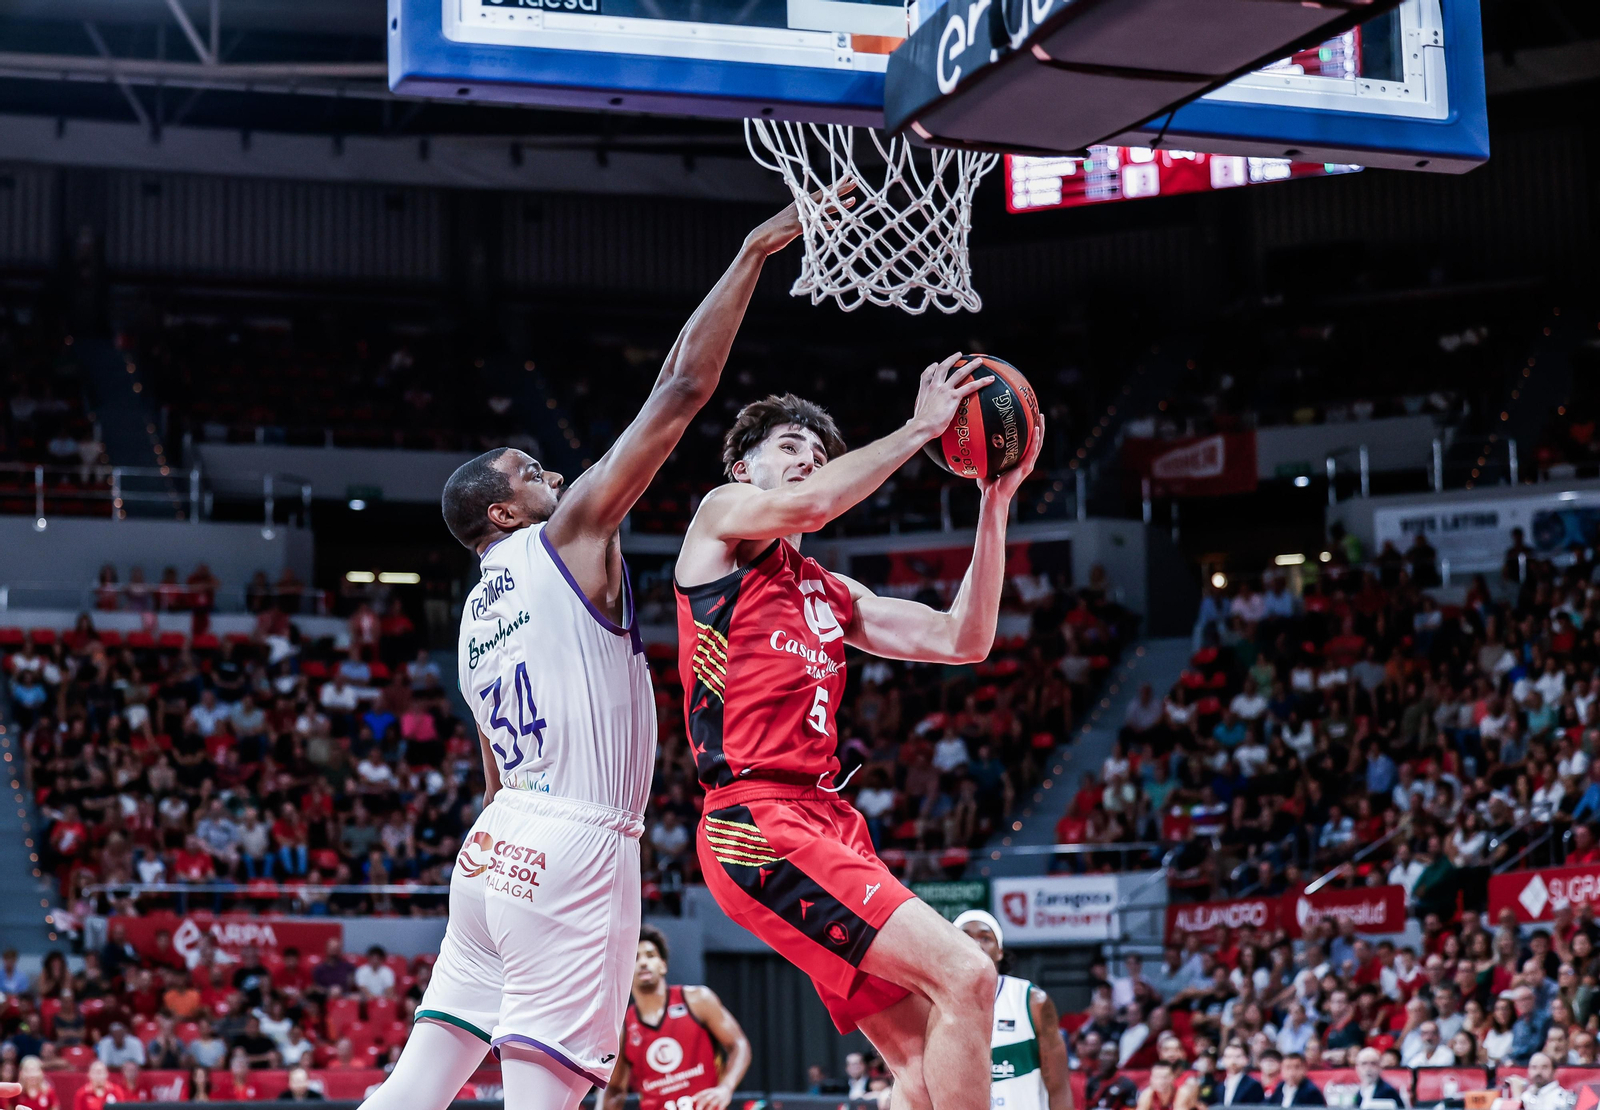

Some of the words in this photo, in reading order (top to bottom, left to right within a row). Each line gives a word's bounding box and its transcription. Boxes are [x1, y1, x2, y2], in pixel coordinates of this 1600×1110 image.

[479, 661, 547, 770] 34
[806, 685, 830, 737] 5
[488, 857, 506, 875] DEL
[508, 865, 540, 887] SOL
[494, 841, 546, 870] COSTA
